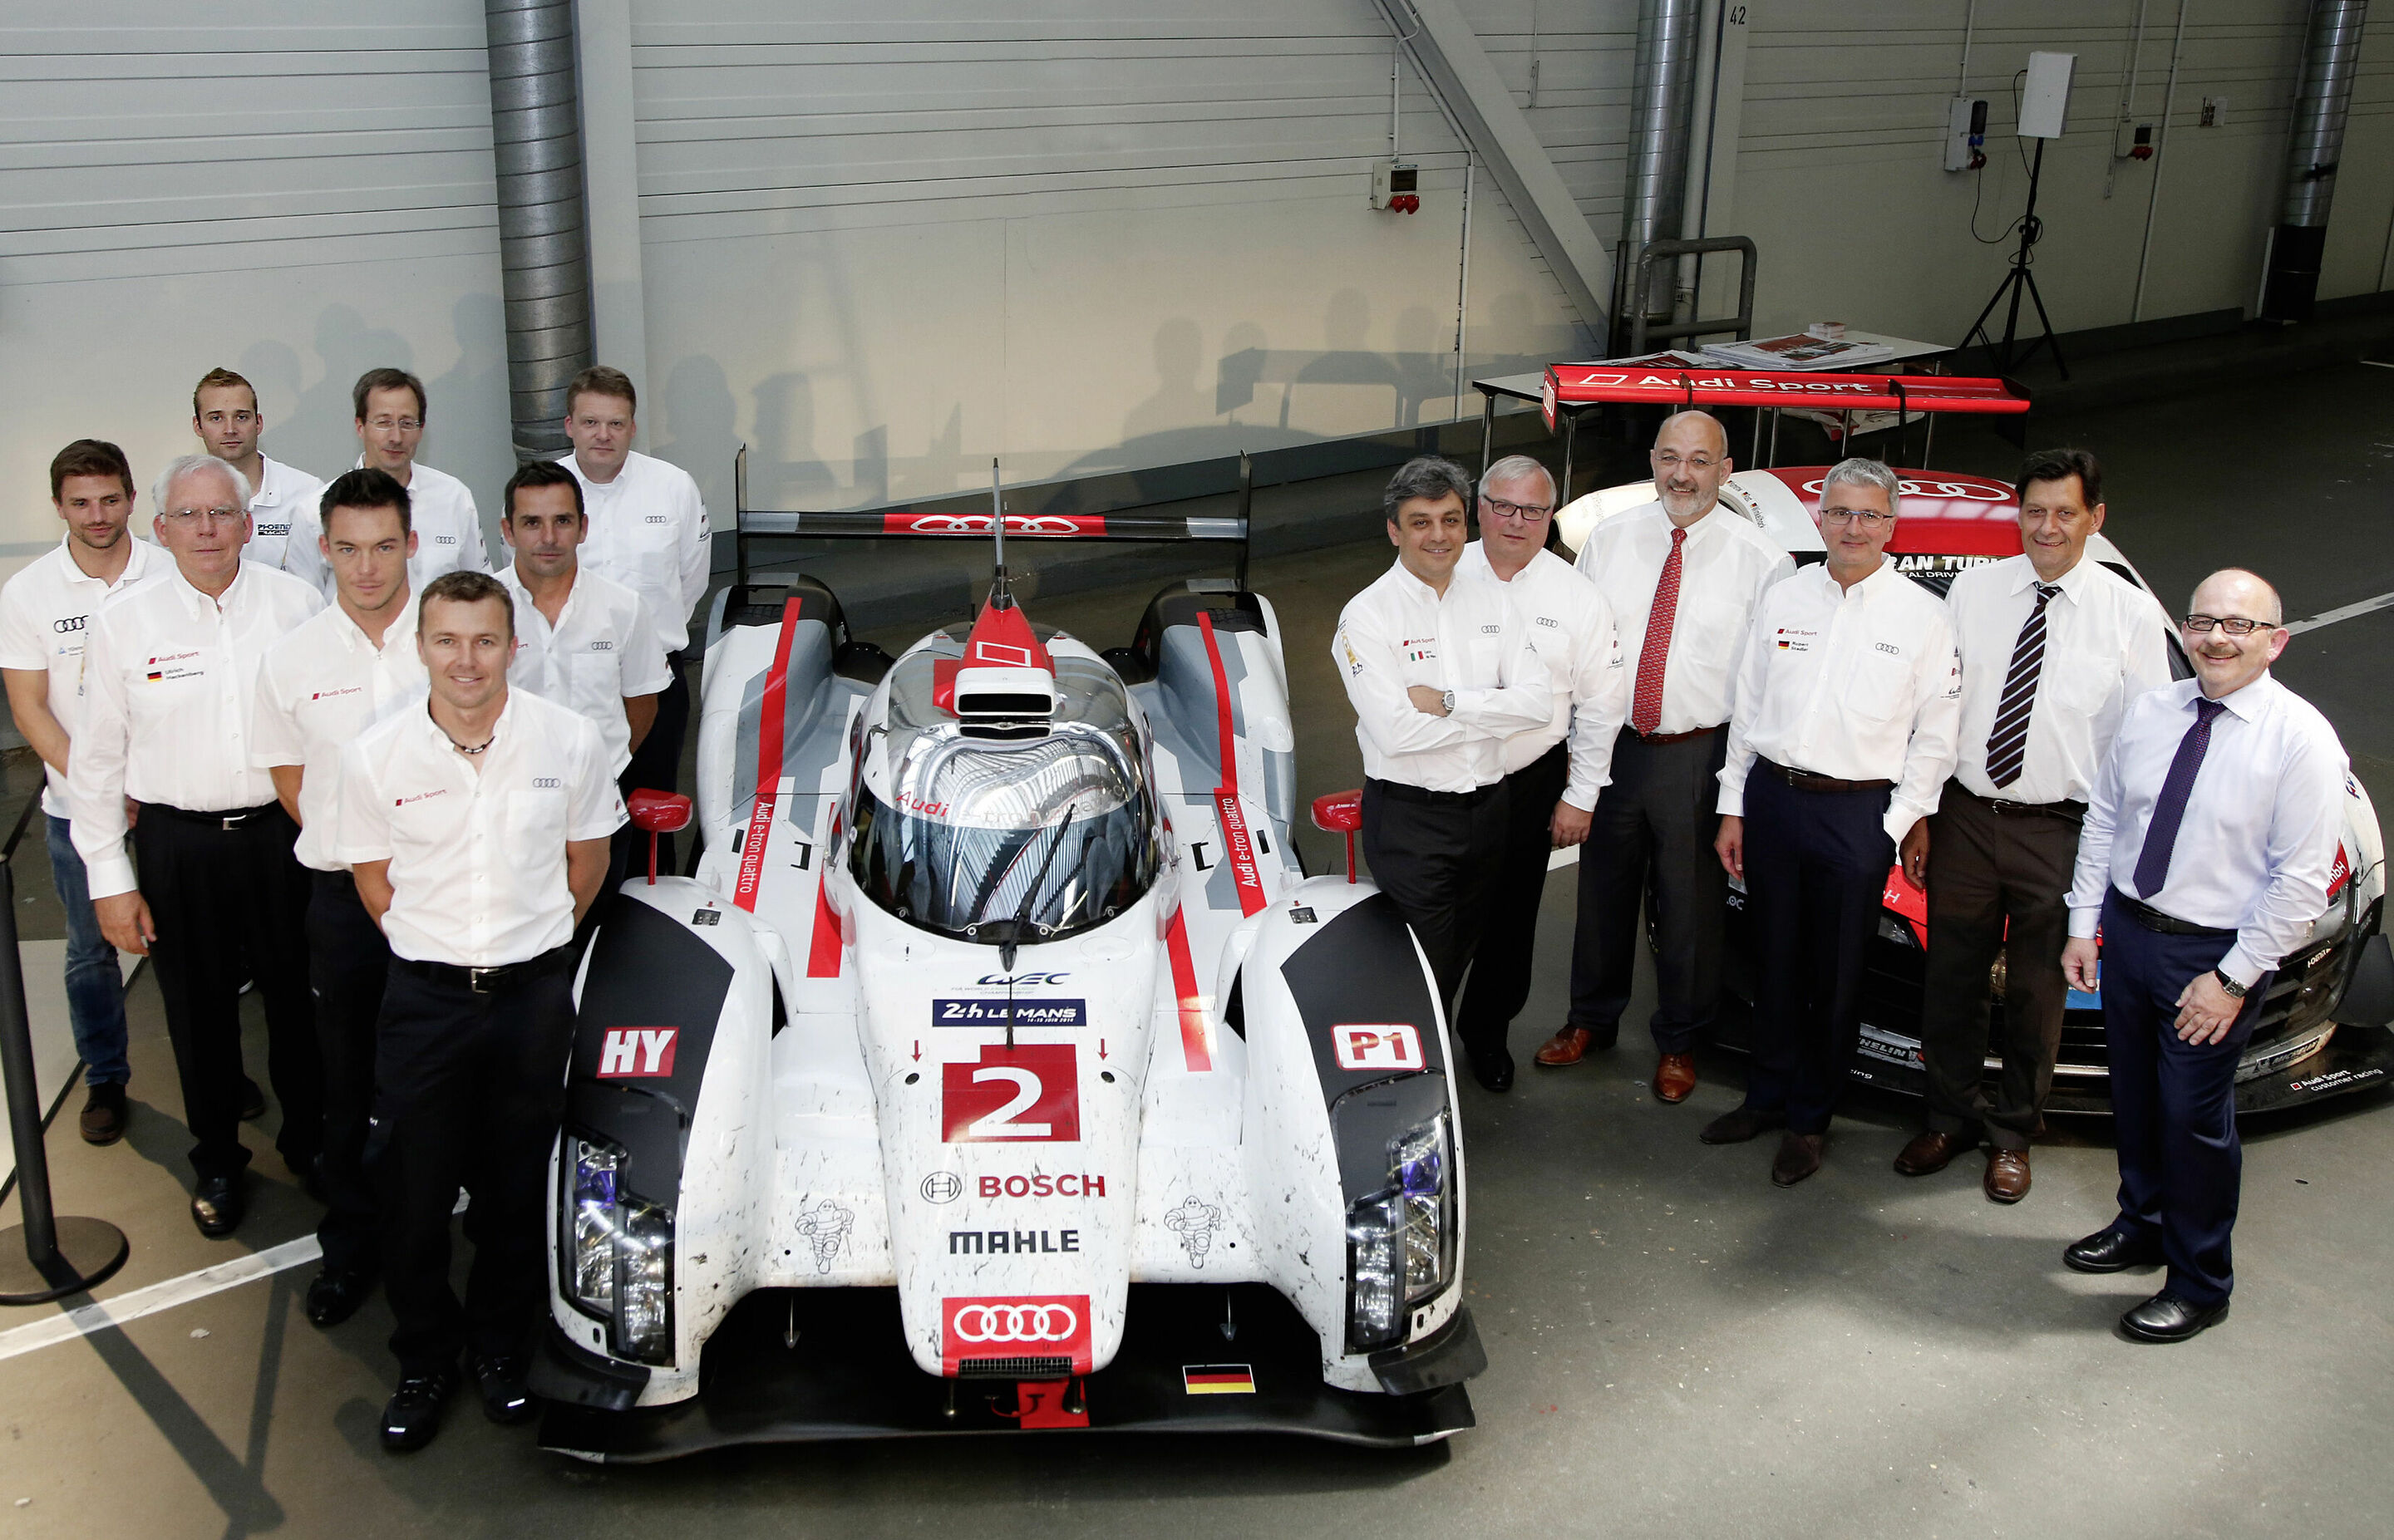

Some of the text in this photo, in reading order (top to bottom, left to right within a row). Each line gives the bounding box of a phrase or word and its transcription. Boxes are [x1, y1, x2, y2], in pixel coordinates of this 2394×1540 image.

[1730, 6, 1746, 25] 42
[1638, 376, 1872, 392] Audi Sport
[176, 651, 200, 659] Sport
[340, 686, 363, 695] Sport
[404, 790, 447, 803] Audi Sport
[896, 790, 949, 817] Audi
[739, 802, 774, 893] Audi e-tron quattro
[1222, 798, 1258, 887] Audi e-tron quattro
[978, 972, 1071, 985] WEC
[942, 1002, 1076, 1018] 24h LE MANS
[600, 1030, 676, 1074] HY
[1349, 1032, 1407, 1060] P1
[2301, 1070, 2351, 1086] Audi Sport
[2311, 1069, 2384, 1091] customer racing
[968, 1066, 1052, 1136] 2
[978, 1174, 1106, 1198] BOSCH
[949, 1230, 1079, 1254] MAHLE
